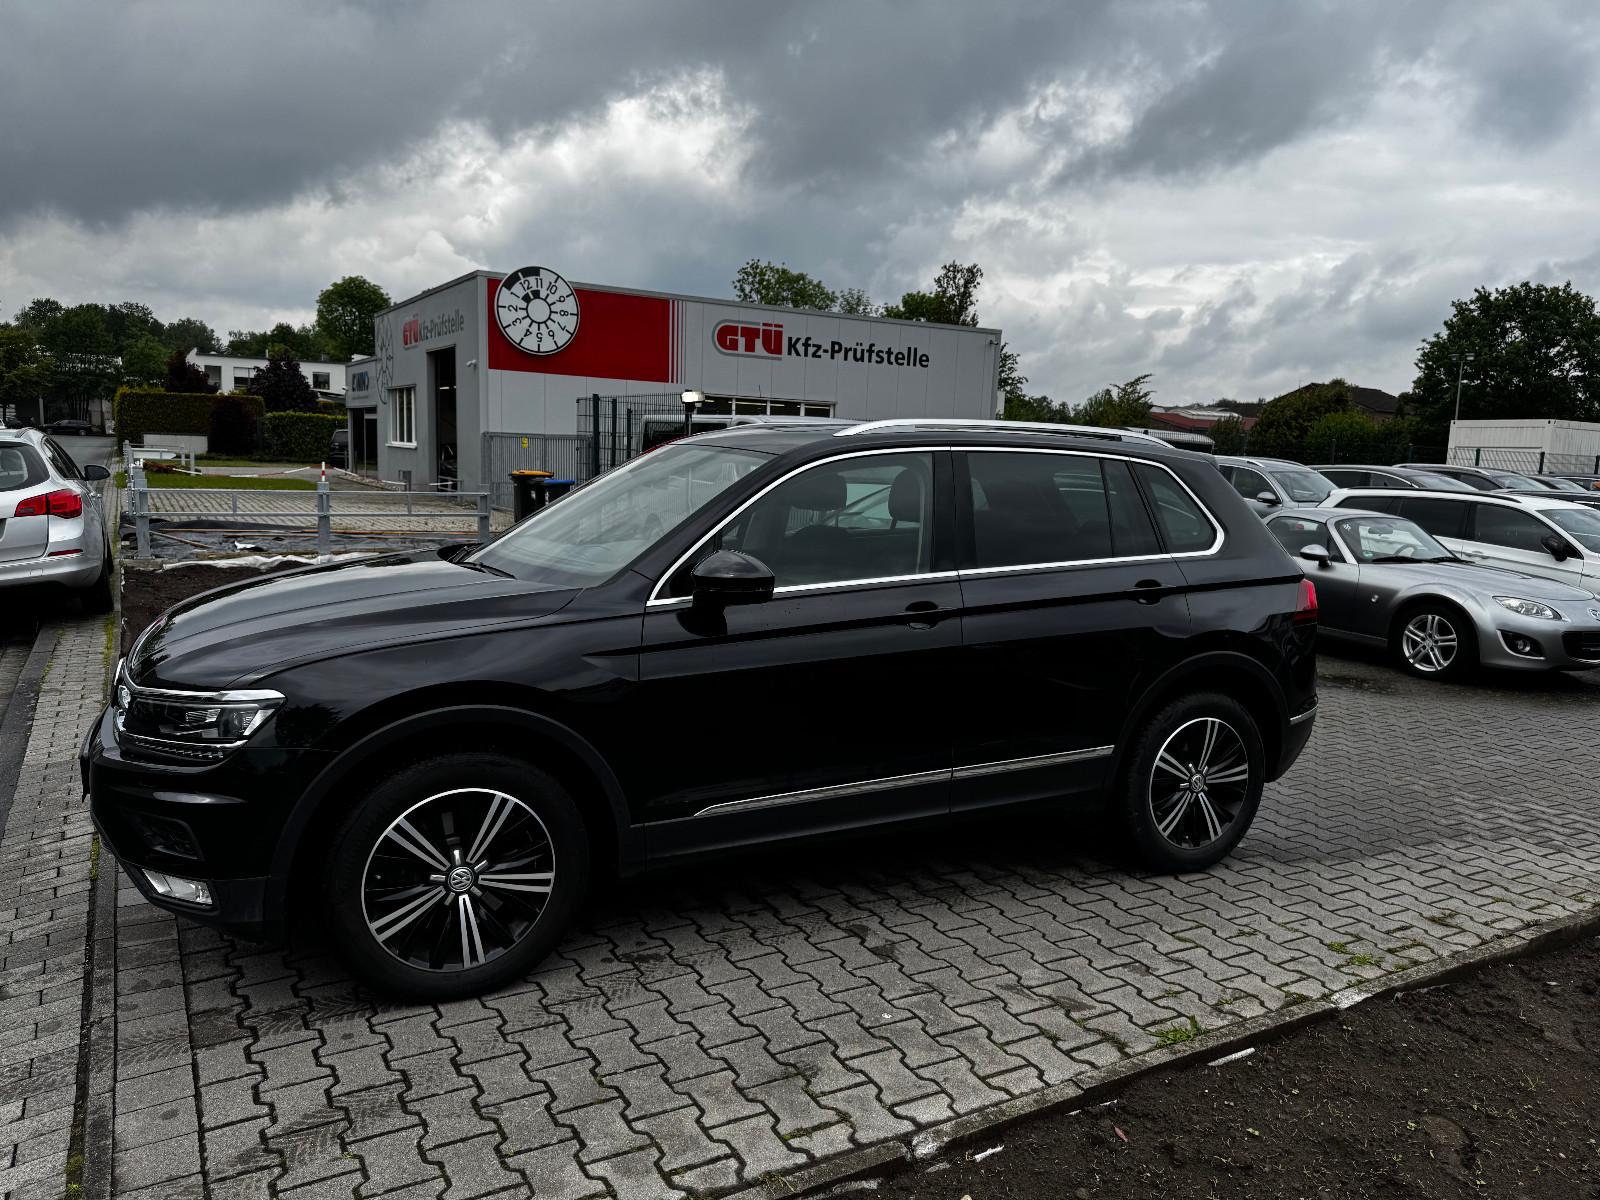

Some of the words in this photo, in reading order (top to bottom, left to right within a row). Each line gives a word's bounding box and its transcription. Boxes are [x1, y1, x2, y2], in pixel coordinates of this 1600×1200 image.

[520, 279, 532, 292] 12
[535, 277, 543, 289] 11
[546, 281, 558, 295] 10
[556, 295, 566, 303] 9
[507, 304, 518, 312] 2
[559, 309, 569, 317] 8
[511, 317, 522, 326] 3
[557, 321, 567, 331] 7
[523, 328, 533, 338] 4
[536, 331, 543, 342] 5
[547, 329, 555, 340] 6
[716, 322, 784, 356] GTÜ
[786, 336, 930, 368] Kfz-Prüfstelle
